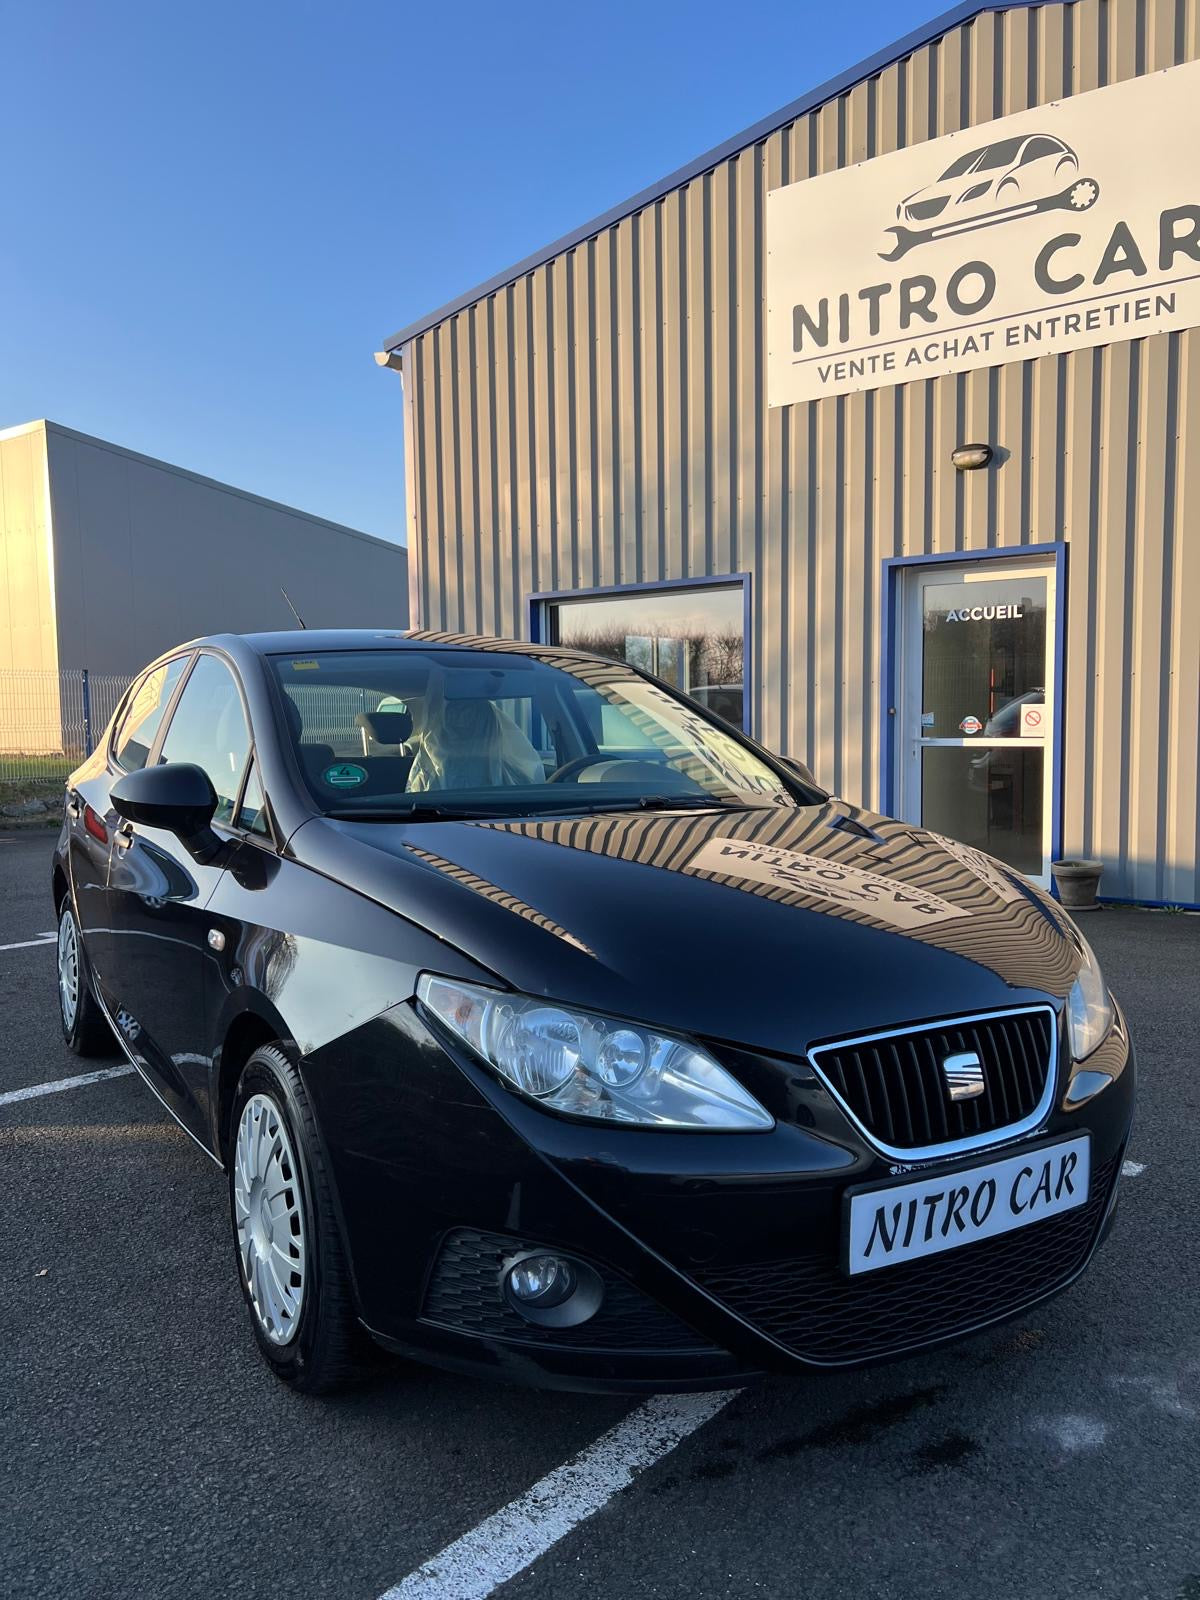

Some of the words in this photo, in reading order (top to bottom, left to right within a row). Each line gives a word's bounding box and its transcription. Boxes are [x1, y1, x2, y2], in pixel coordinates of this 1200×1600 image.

[792, 260, 996, 353] NITRO
[1034, 204, 1200, 295] CAR
[817, 351, 896, 383] VENTE
[905, 331, 995, 368] ACHAT
[1006, 292, 1177, 347] ENTRETIEN
[945, 604, 1023, 623] ACCUEIL
[863, 1177, 997, 1258] NITRO
[1009, 1150, 1078, 1215] CAR
